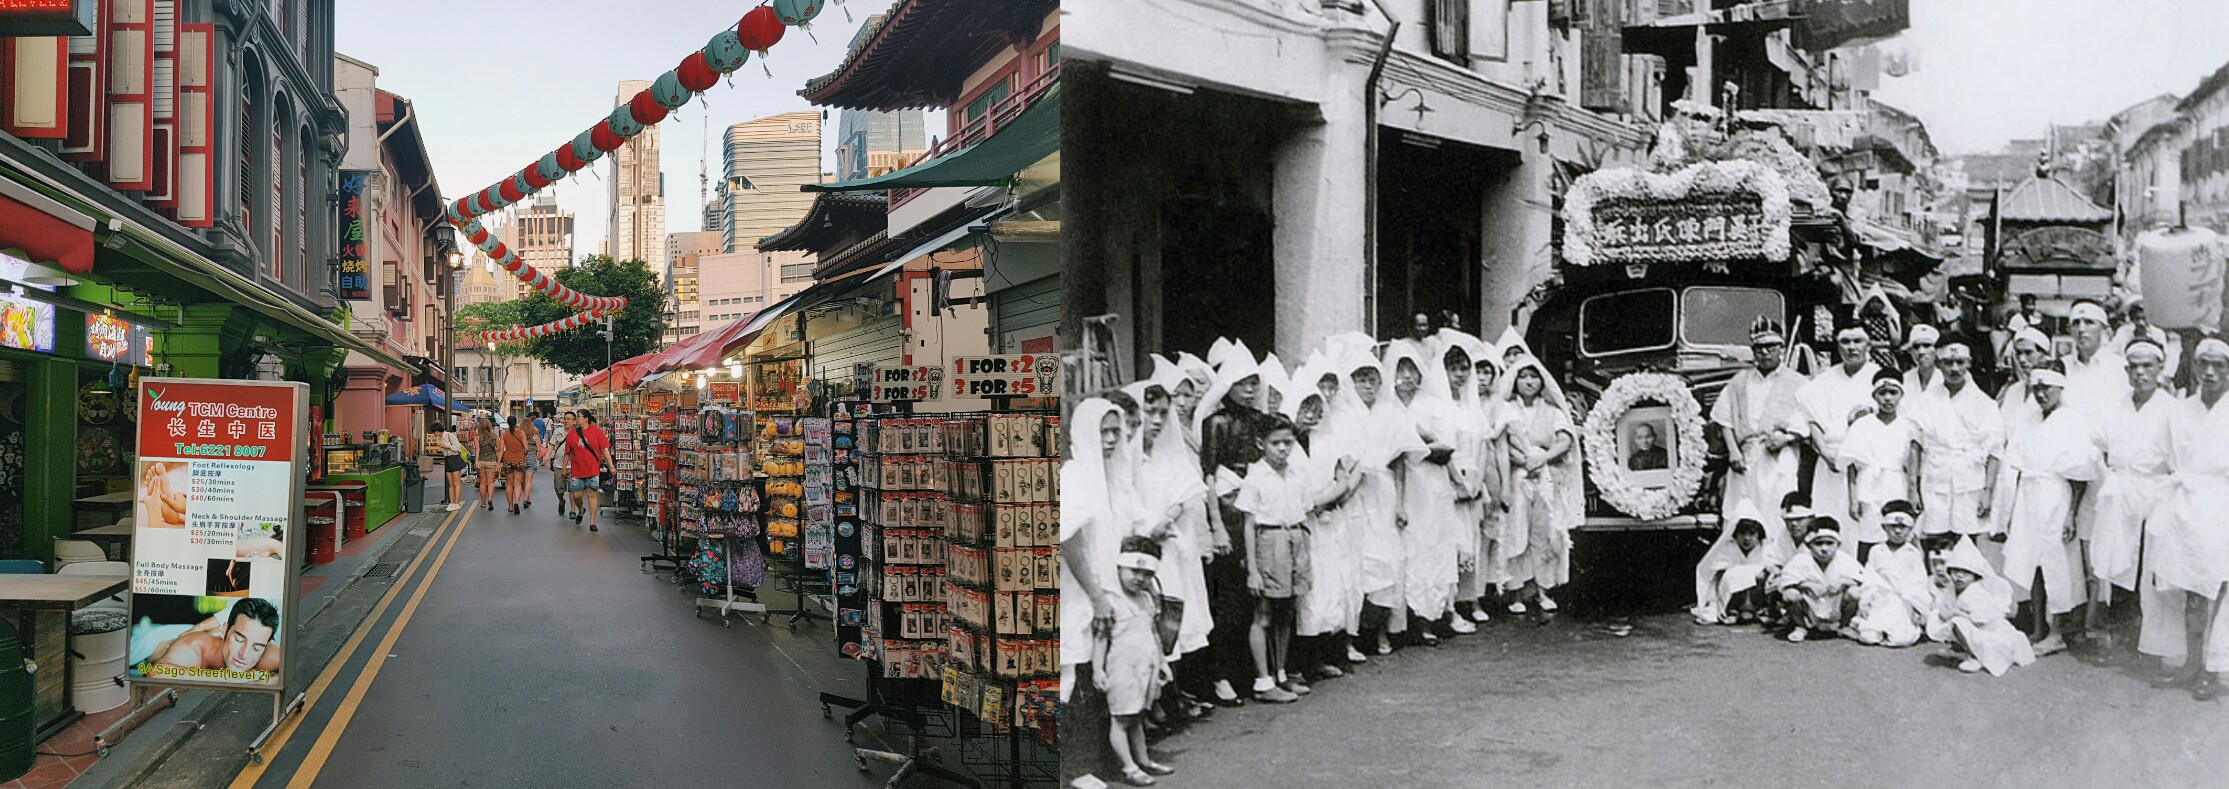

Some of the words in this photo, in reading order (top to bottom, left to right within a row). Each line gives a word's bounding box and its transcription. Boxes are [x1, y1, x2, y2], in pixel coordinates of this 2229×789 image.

[342, 260, 368, 273] 烧烤
[342, 275, 368, 289] 自助
[955, 357, 964, 374] 1
[970, 358, 1007, 374] FOR
[1011, 355, 1034, 373] $2
[875, 367, 881, 382] 1
[885, 368, 910, 382] FOR
[912, 367, 928, 382] $2
[873, 385, 881, 401] 3
[884, 386, 909, 400] FOR
[911, 385, 928, 400] $5
[954, 378, 965, 395] 3
[970, 379, 1007, 394] FOR
[1011, 378, 1036, 394] $5
[151, 387, 186, 417] Young
[188, 402, 224, 417] TCM
[226, 404, 277, 419] Centre
[167, 417, 276, 440] 长生中医
[175, 443, 231, 456] Tel:6221
[234, 446, 266, 457] 8007
[211, 462, 255, 471] Reflexology
[219, 513, 253, 521] Shoulder
[254, 515, 288, 523] Massage
[151, 562, 170, 570] Body
[171, 562, 204, 571] Massage
